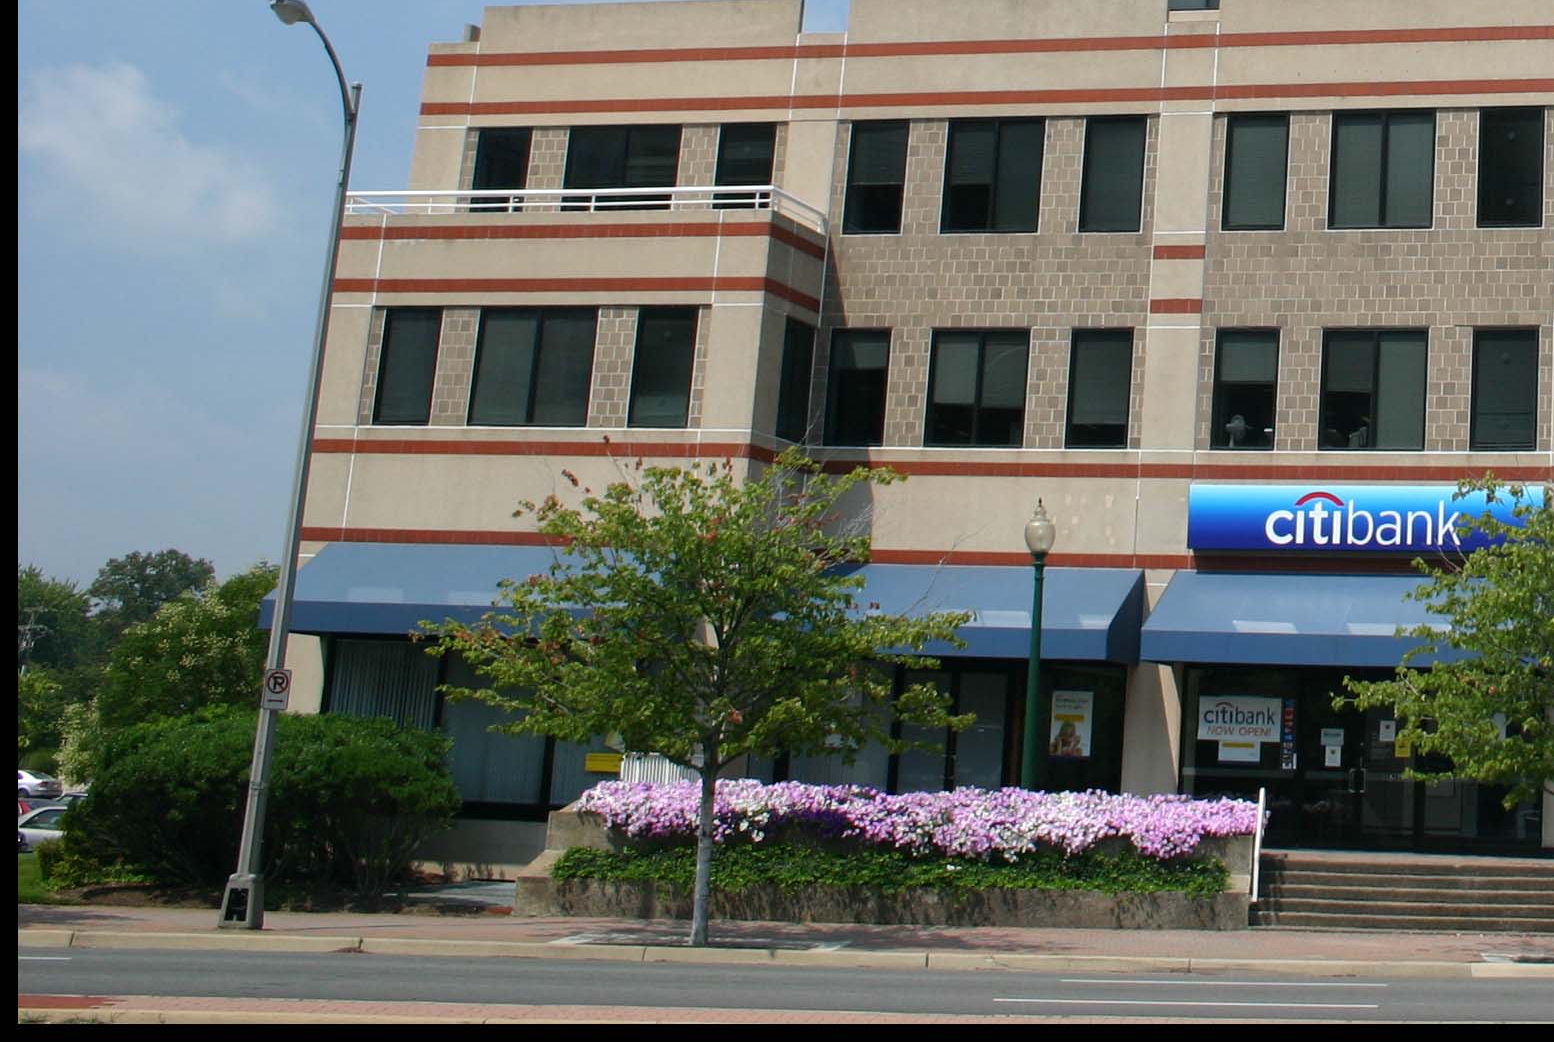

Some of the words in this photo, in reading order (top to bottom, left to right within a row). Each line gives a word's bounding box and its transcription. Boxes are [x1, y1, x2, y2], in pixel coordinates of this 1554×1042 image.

[1264, 499, 1461, 546] citibank
[1203, 706, 1275, 726] citibank
[1207, 726, 1234, 736] NOW
